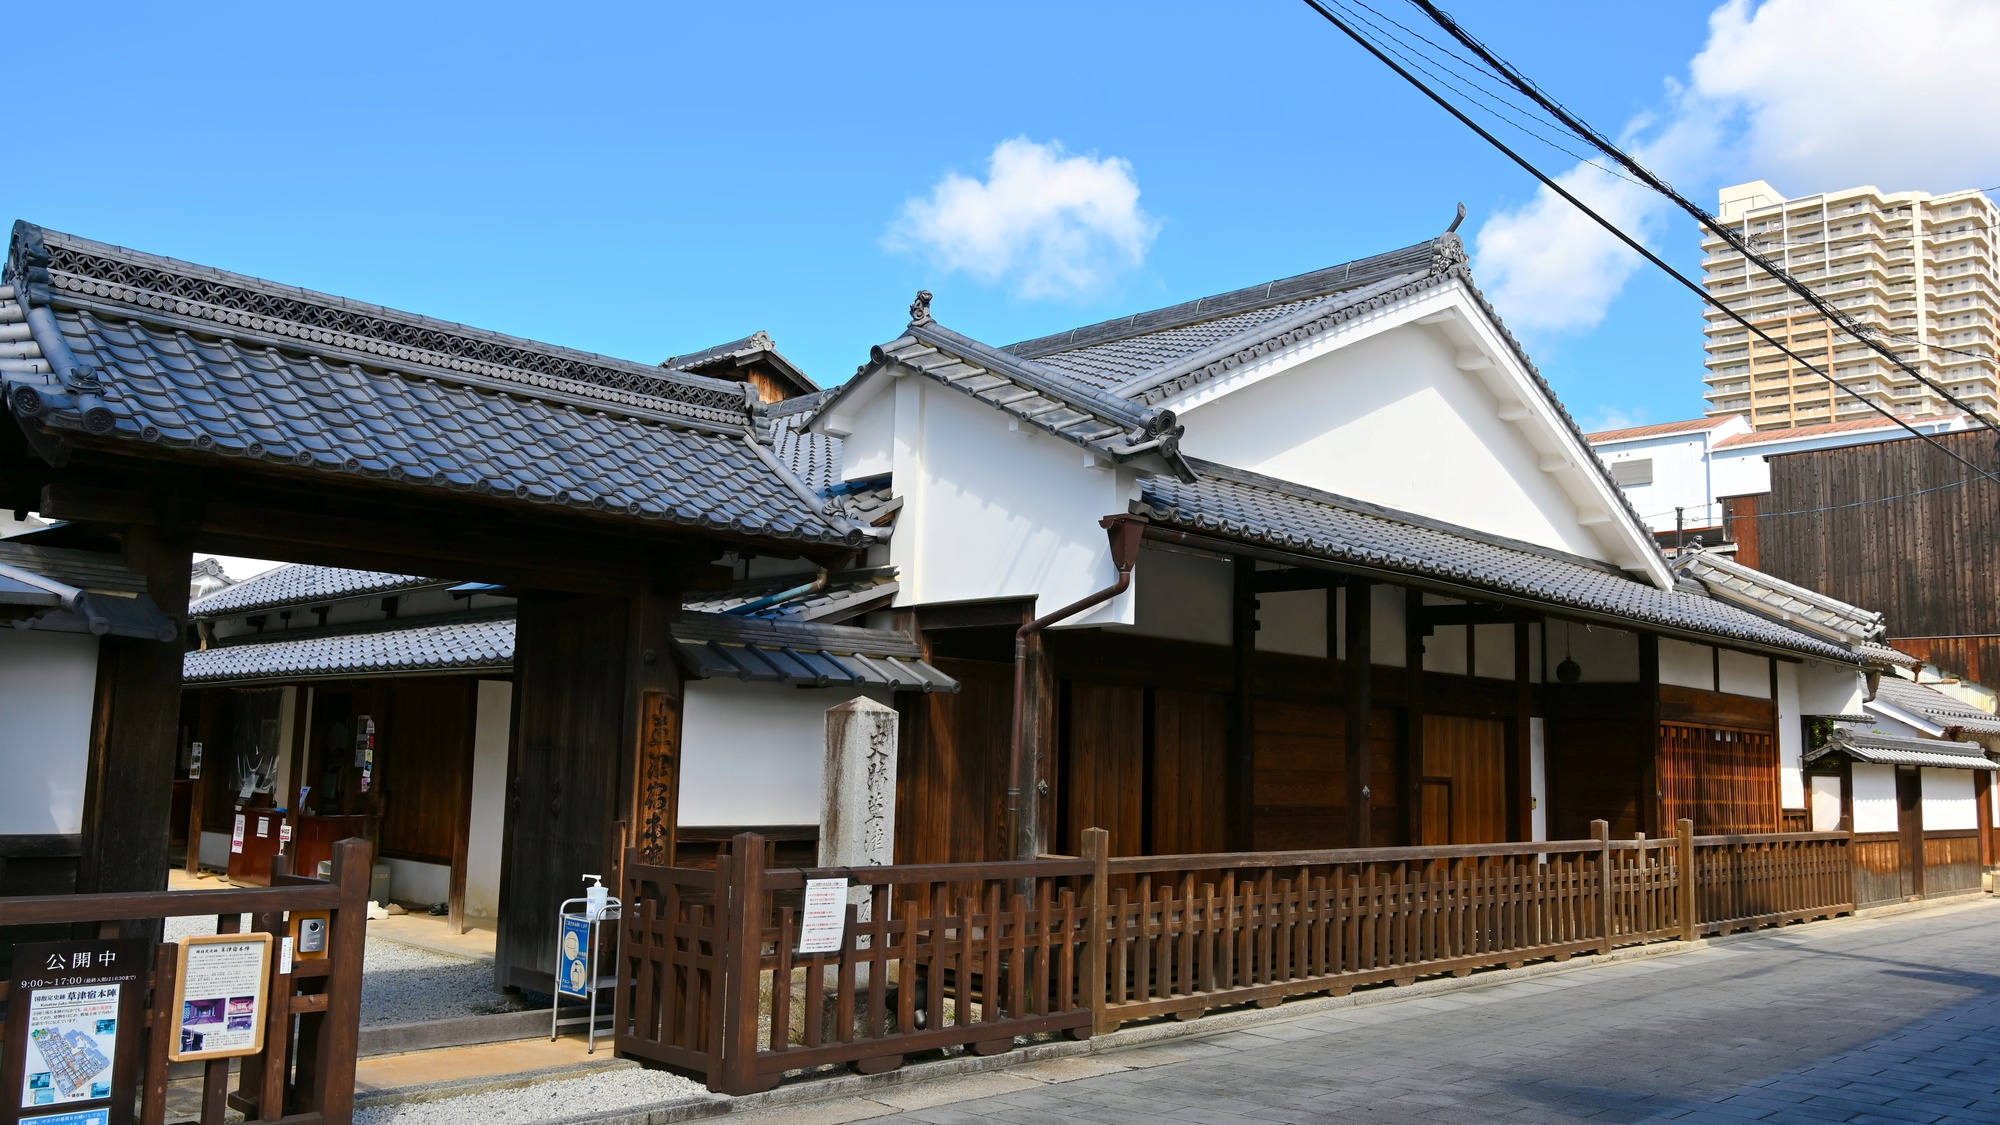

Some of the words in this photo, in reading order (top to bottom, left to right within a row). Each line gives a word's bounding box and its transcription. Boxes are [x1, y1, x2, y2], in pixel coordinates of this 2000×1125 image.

[46, 950, 116, 970] 公開中
[67, 988, 117, 1001] 草津宿本陣
